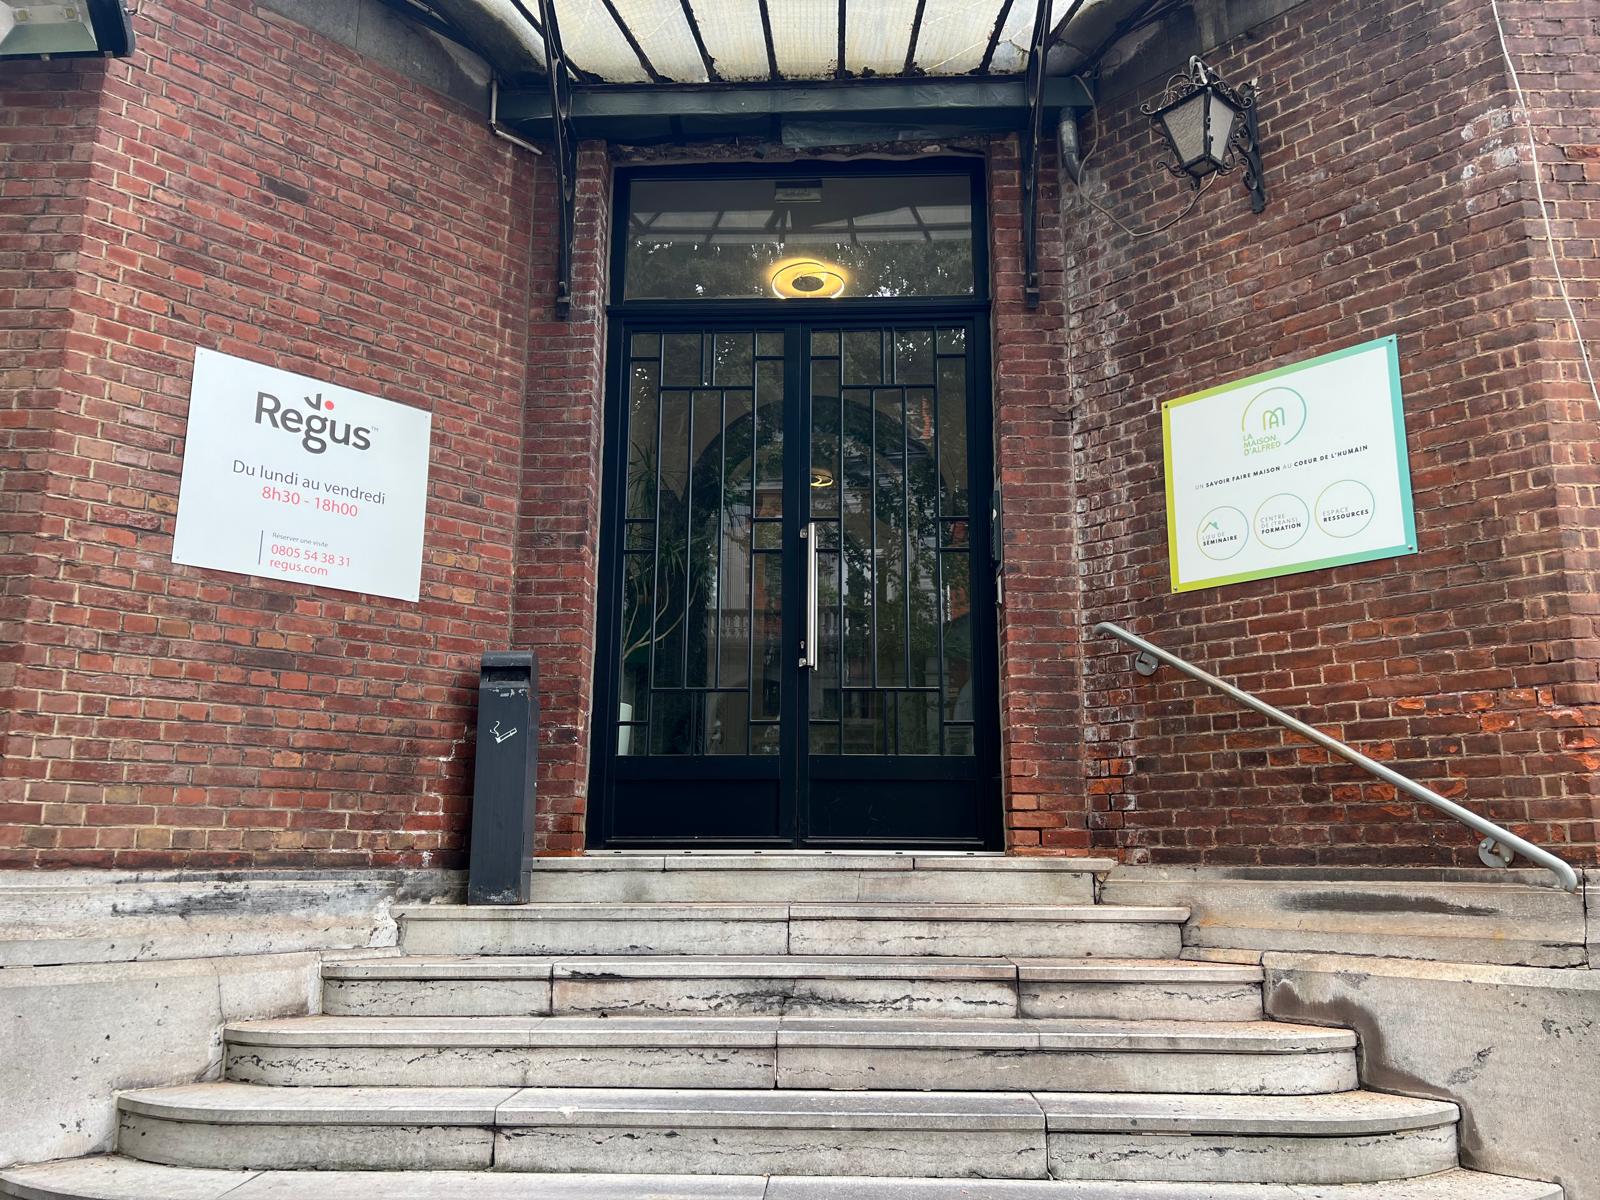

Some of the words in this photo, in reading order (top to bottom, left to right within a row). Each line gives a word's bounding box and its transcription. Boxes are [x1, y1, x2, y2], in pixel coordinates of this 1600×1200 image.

[255, 391, 371, 455] Regus
[1243, 433, 1253, 442] LA
[1243, 434, 1277, 449] MAISON
[1243, 440, 1281, 456] D'ALFRED
[1206, 478, 1230, 488] SAVOIR
[1232, 473, 1251, 482] FAIRE
[1253, 466, 1281, 477] MAISON
[1293, 457, 1318, 467] COEUR
[1331, 444, 1368, 459] L'HUMAIN
[233, 459, 255, 477] Du
[260, 465, 299, 486] lundi
[302, 478, 320, 491] au
[324, 482, 386, 505] vendredi
[262, 486, 301, 505] 8h30
[315, 497, 359, 518] 18h00
[1260, 513, 1285, 523] CENTRE
[1323, 507, 1348, 517] ESPACE
[1323, 509, 1369, 523] RESSOURCES
[1261, 522, 1302, 535] FORMATION
[271, 544, 301, 559] 0805
[303, 550, 318, 561] 54
[320, 552, 335, 565] 38
[338, 555, 351, 567] 31
[269, 559, 329, 576] regus.com
